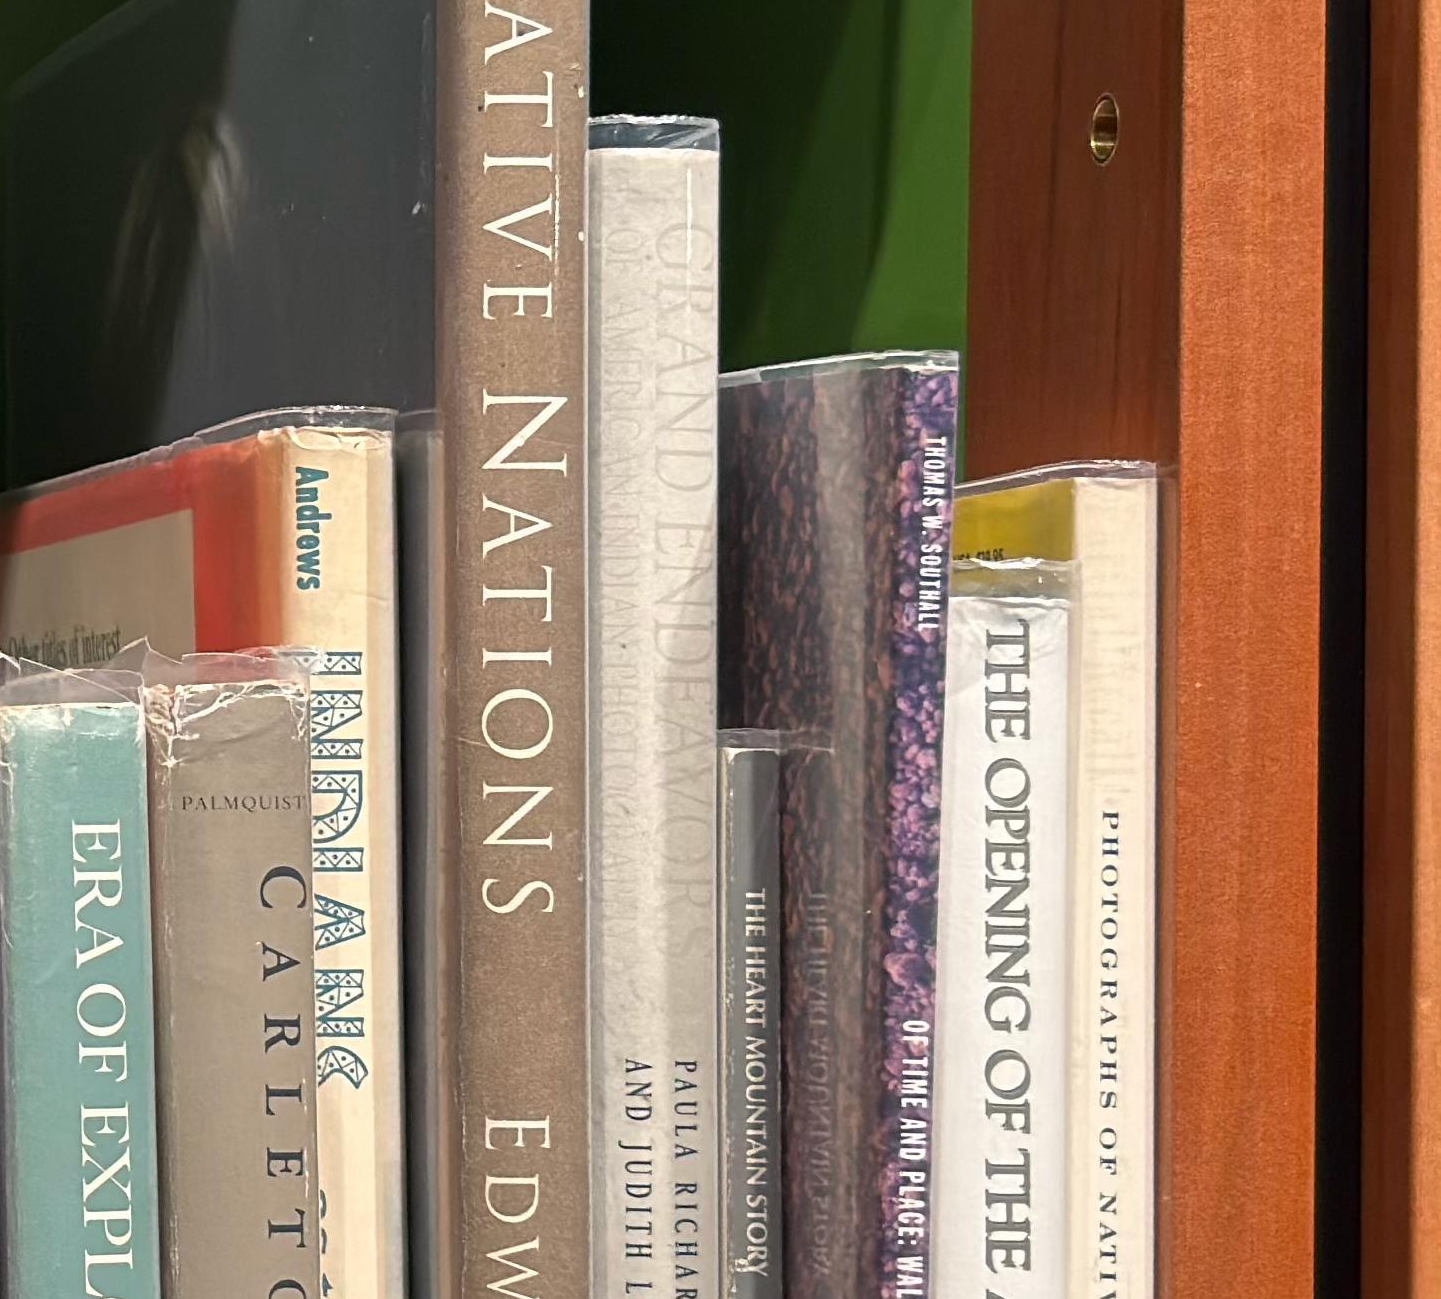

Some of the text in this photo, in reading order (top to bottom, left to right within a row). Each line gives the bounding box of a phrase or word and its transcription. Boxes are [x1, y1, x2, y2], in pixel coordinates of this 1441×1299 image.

[295, 466, 330, 590] Andrews
[917, 437, 948, 631] THOMAS W. SOUTHALL
[479, 389, 569, 914] NATIONS
[984, 618, 1032, 743] THE
[70, 819, 124, 969] ERA
[983, 757, 1032, 1034] OPENING
[76, 982, 129, 1083] OF
[744, 888, 769, 1276] THE HEART MOUNTAIN STORY
[984, 1050, 1032, 1134] OF
[674, 1059, 699, 1159] PAULA
[984, 1148, 1032, 1273] THE
